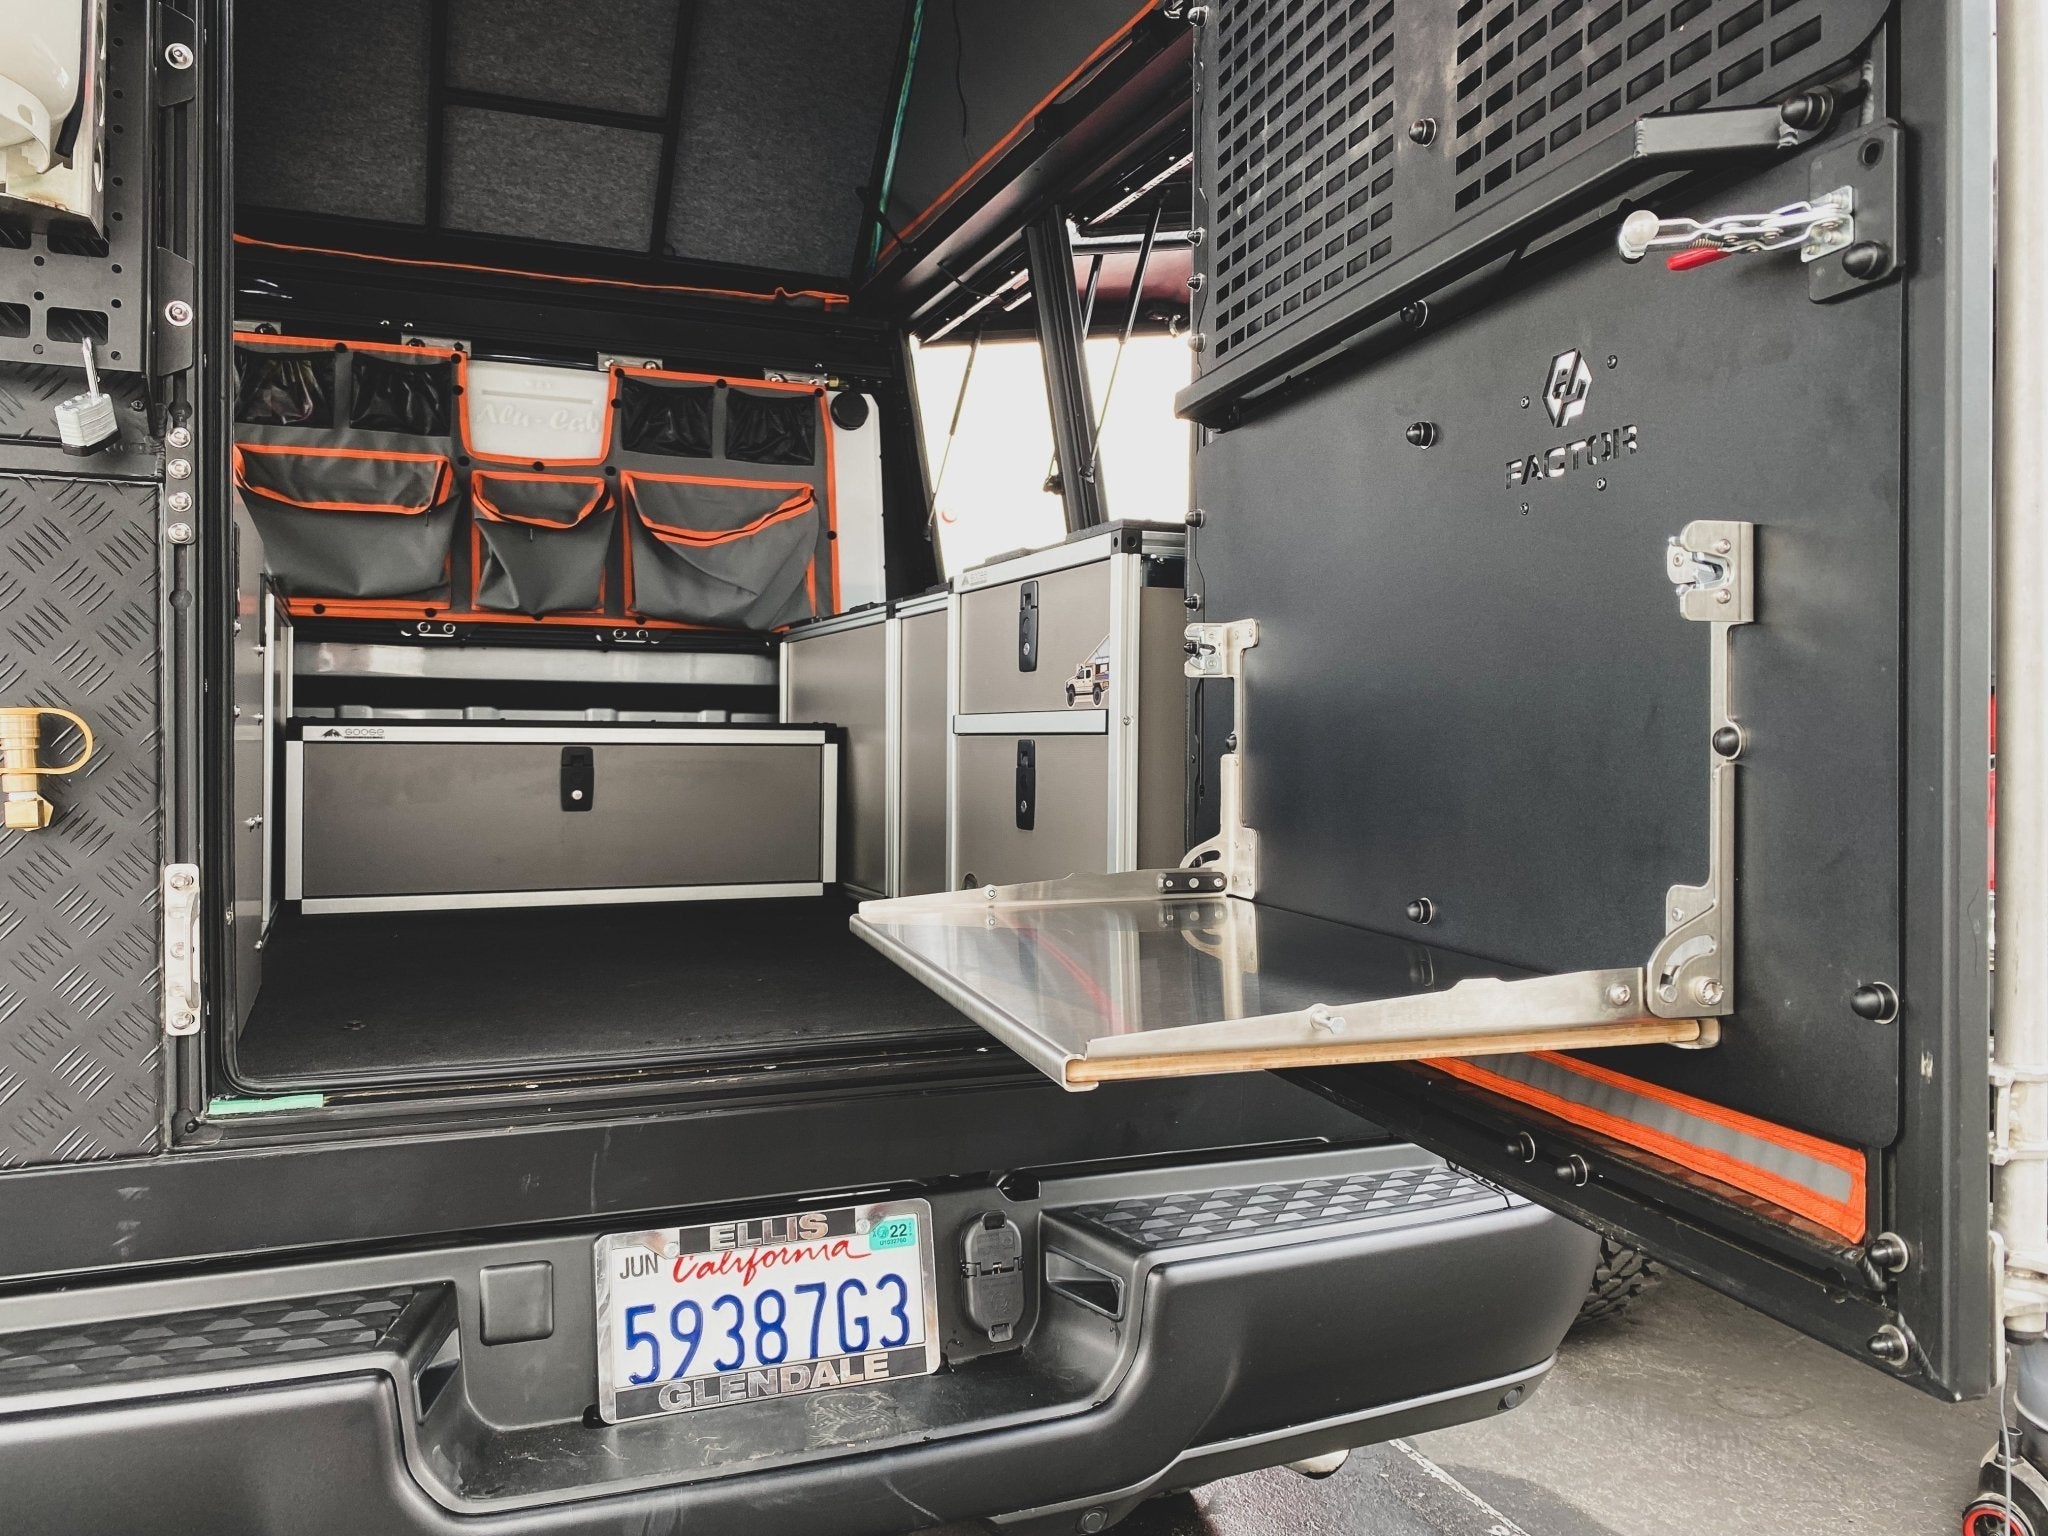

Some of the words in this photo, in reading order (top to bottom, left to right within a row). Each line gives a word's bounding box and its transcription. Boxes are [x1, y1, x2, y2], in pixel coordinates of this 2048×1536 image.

[1505, 423, 1638, 490] FACTOR
[709, 1213, 829, 1251] ELLIS
[889, 1223, 907, 1238] 22
[619, 1253, 660, 1281] JUN
[672, 1239, 872, 1287] California
[624, 1273, 911, 1386] 59387G3
[657, 1352, 891, 1412] GLENDALE
